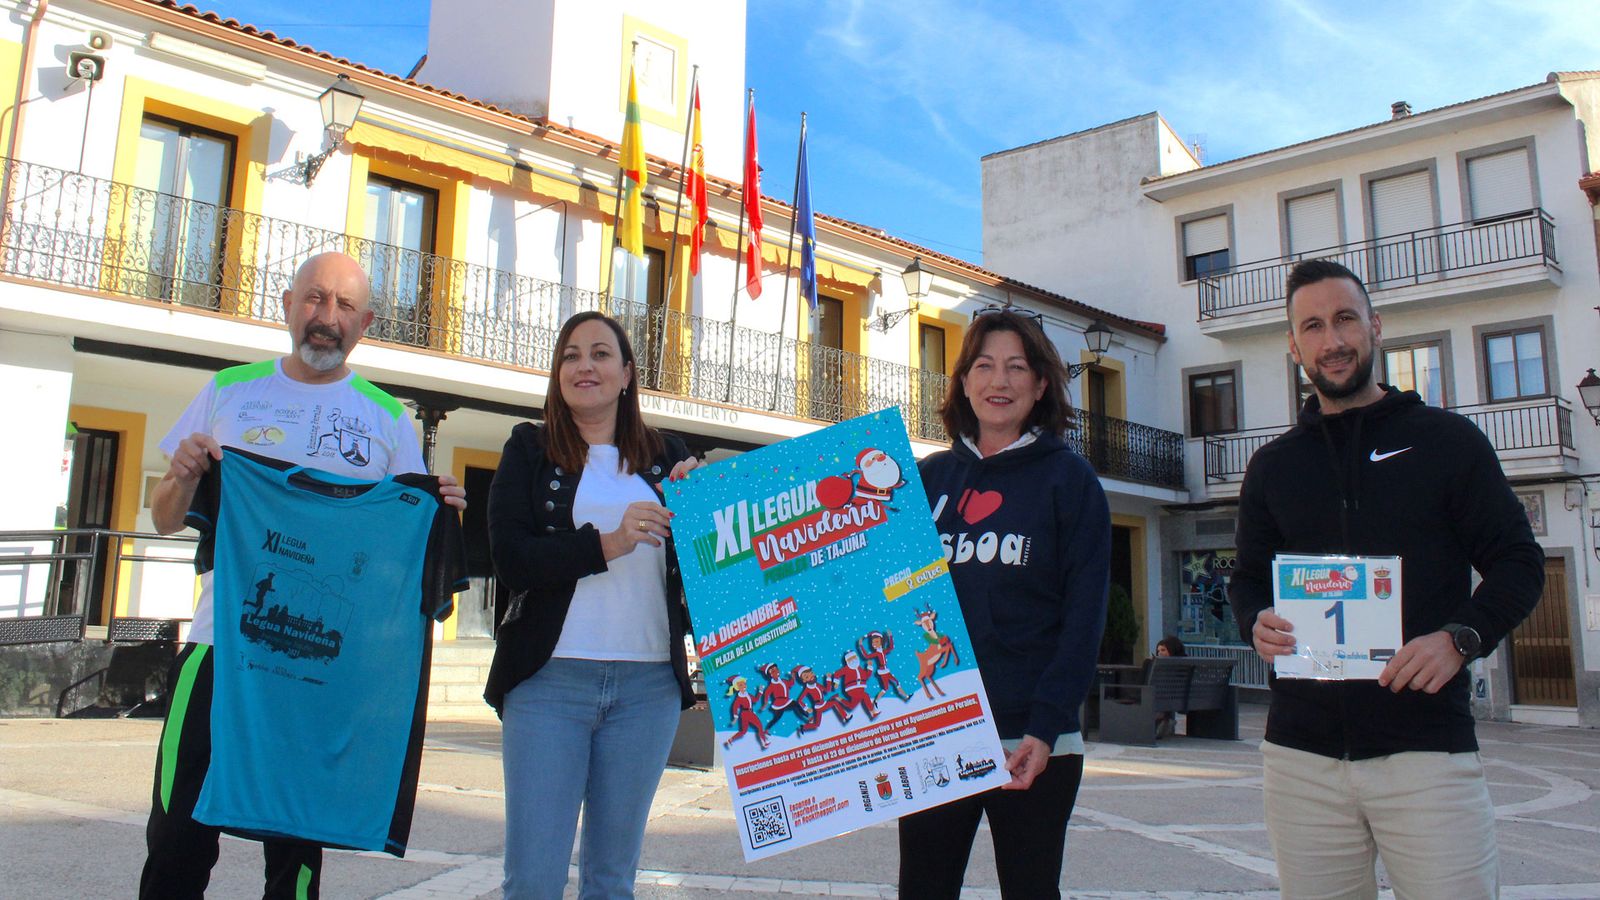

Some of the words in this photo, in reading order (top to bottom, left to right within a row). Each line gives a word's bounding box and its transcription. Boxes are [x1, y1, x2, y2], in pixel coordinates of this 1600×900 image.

[641, 394, 738, 424] UNTAMIENTO
[712, 499, 751, 563] XI
[752, 480, 821, 533] LEGUA
[262, 529, 282, 554] XI
[281, 535, 307, 551] LEGUA
[278, 547, 315, 566] NAVIDEÑA
[810, 550, 825, 567] DE
[827, 532, 867, 561] TAJUÑA
[939, 531, 1026, 566] sboa
[884, 567, 912, 589] PRECIO
[1213, 557, 1236, 569] ROC
[1291, 568, 1306, 586] XI
[1306, 568, 1331, 580] LEGUA
[247, 613, 280, 633] Legua
[283, 626, 336, 648] Navideña
[700, 631, 717, 652] 24
[718, 599, 781, 643] DICIEMBRE
[1324, 601, 1345, 645] 1
[715, 652, 735, 668] PLAZA
[736, 646, 745, 657] DE
[745, 641, 754, 651] LA
[754, 618, 798, 647] CONSTITUCIÓN
[773, 754, 790, 765] hasta
[803, 748, 811, 756] de
[812, 739, 839, 754] diciembre
[910, 707, 947, 724] Ayuntamiento
[807, 755, 822, 765] hasta
[838, 747, 845, 756] de
[846, 740, 874, 754] diciembre
[882, 732, 899, 743] forma
[859, 780, 873, 812] ORGANIZA
[898, 766, 913, 800] COLABORA
